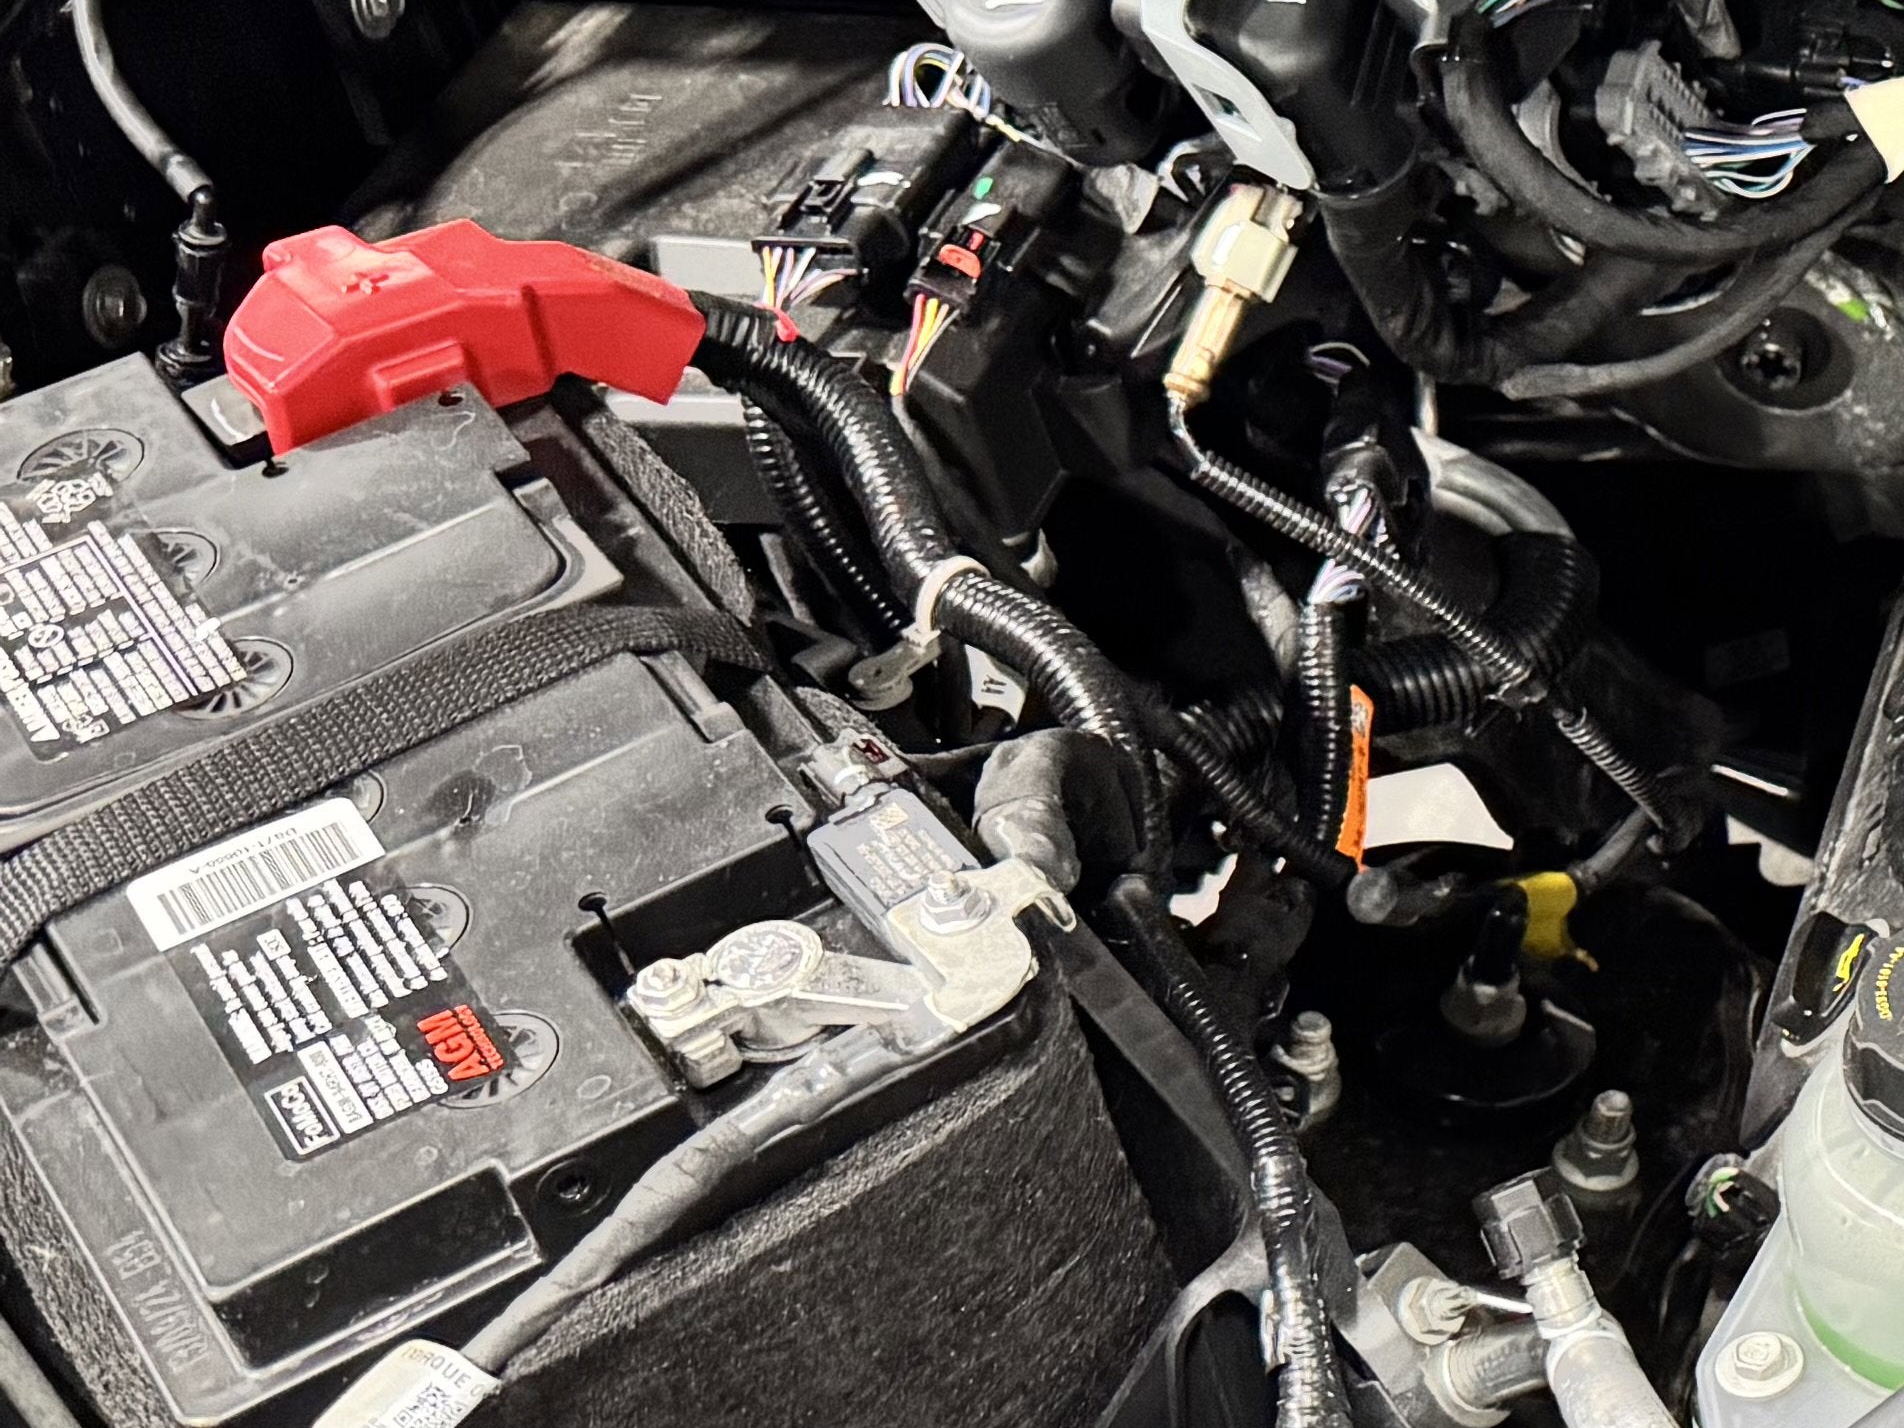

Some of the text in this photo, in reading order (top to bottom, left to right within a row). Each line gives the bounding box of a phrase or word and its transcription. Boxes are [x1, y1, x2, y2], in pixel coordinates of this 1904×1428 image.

[415, 1008, 490, 1081] AGM
[273, 1079, 330, 1149] FoMoCo
[402, 1346, 471, 1389] TORQUE
